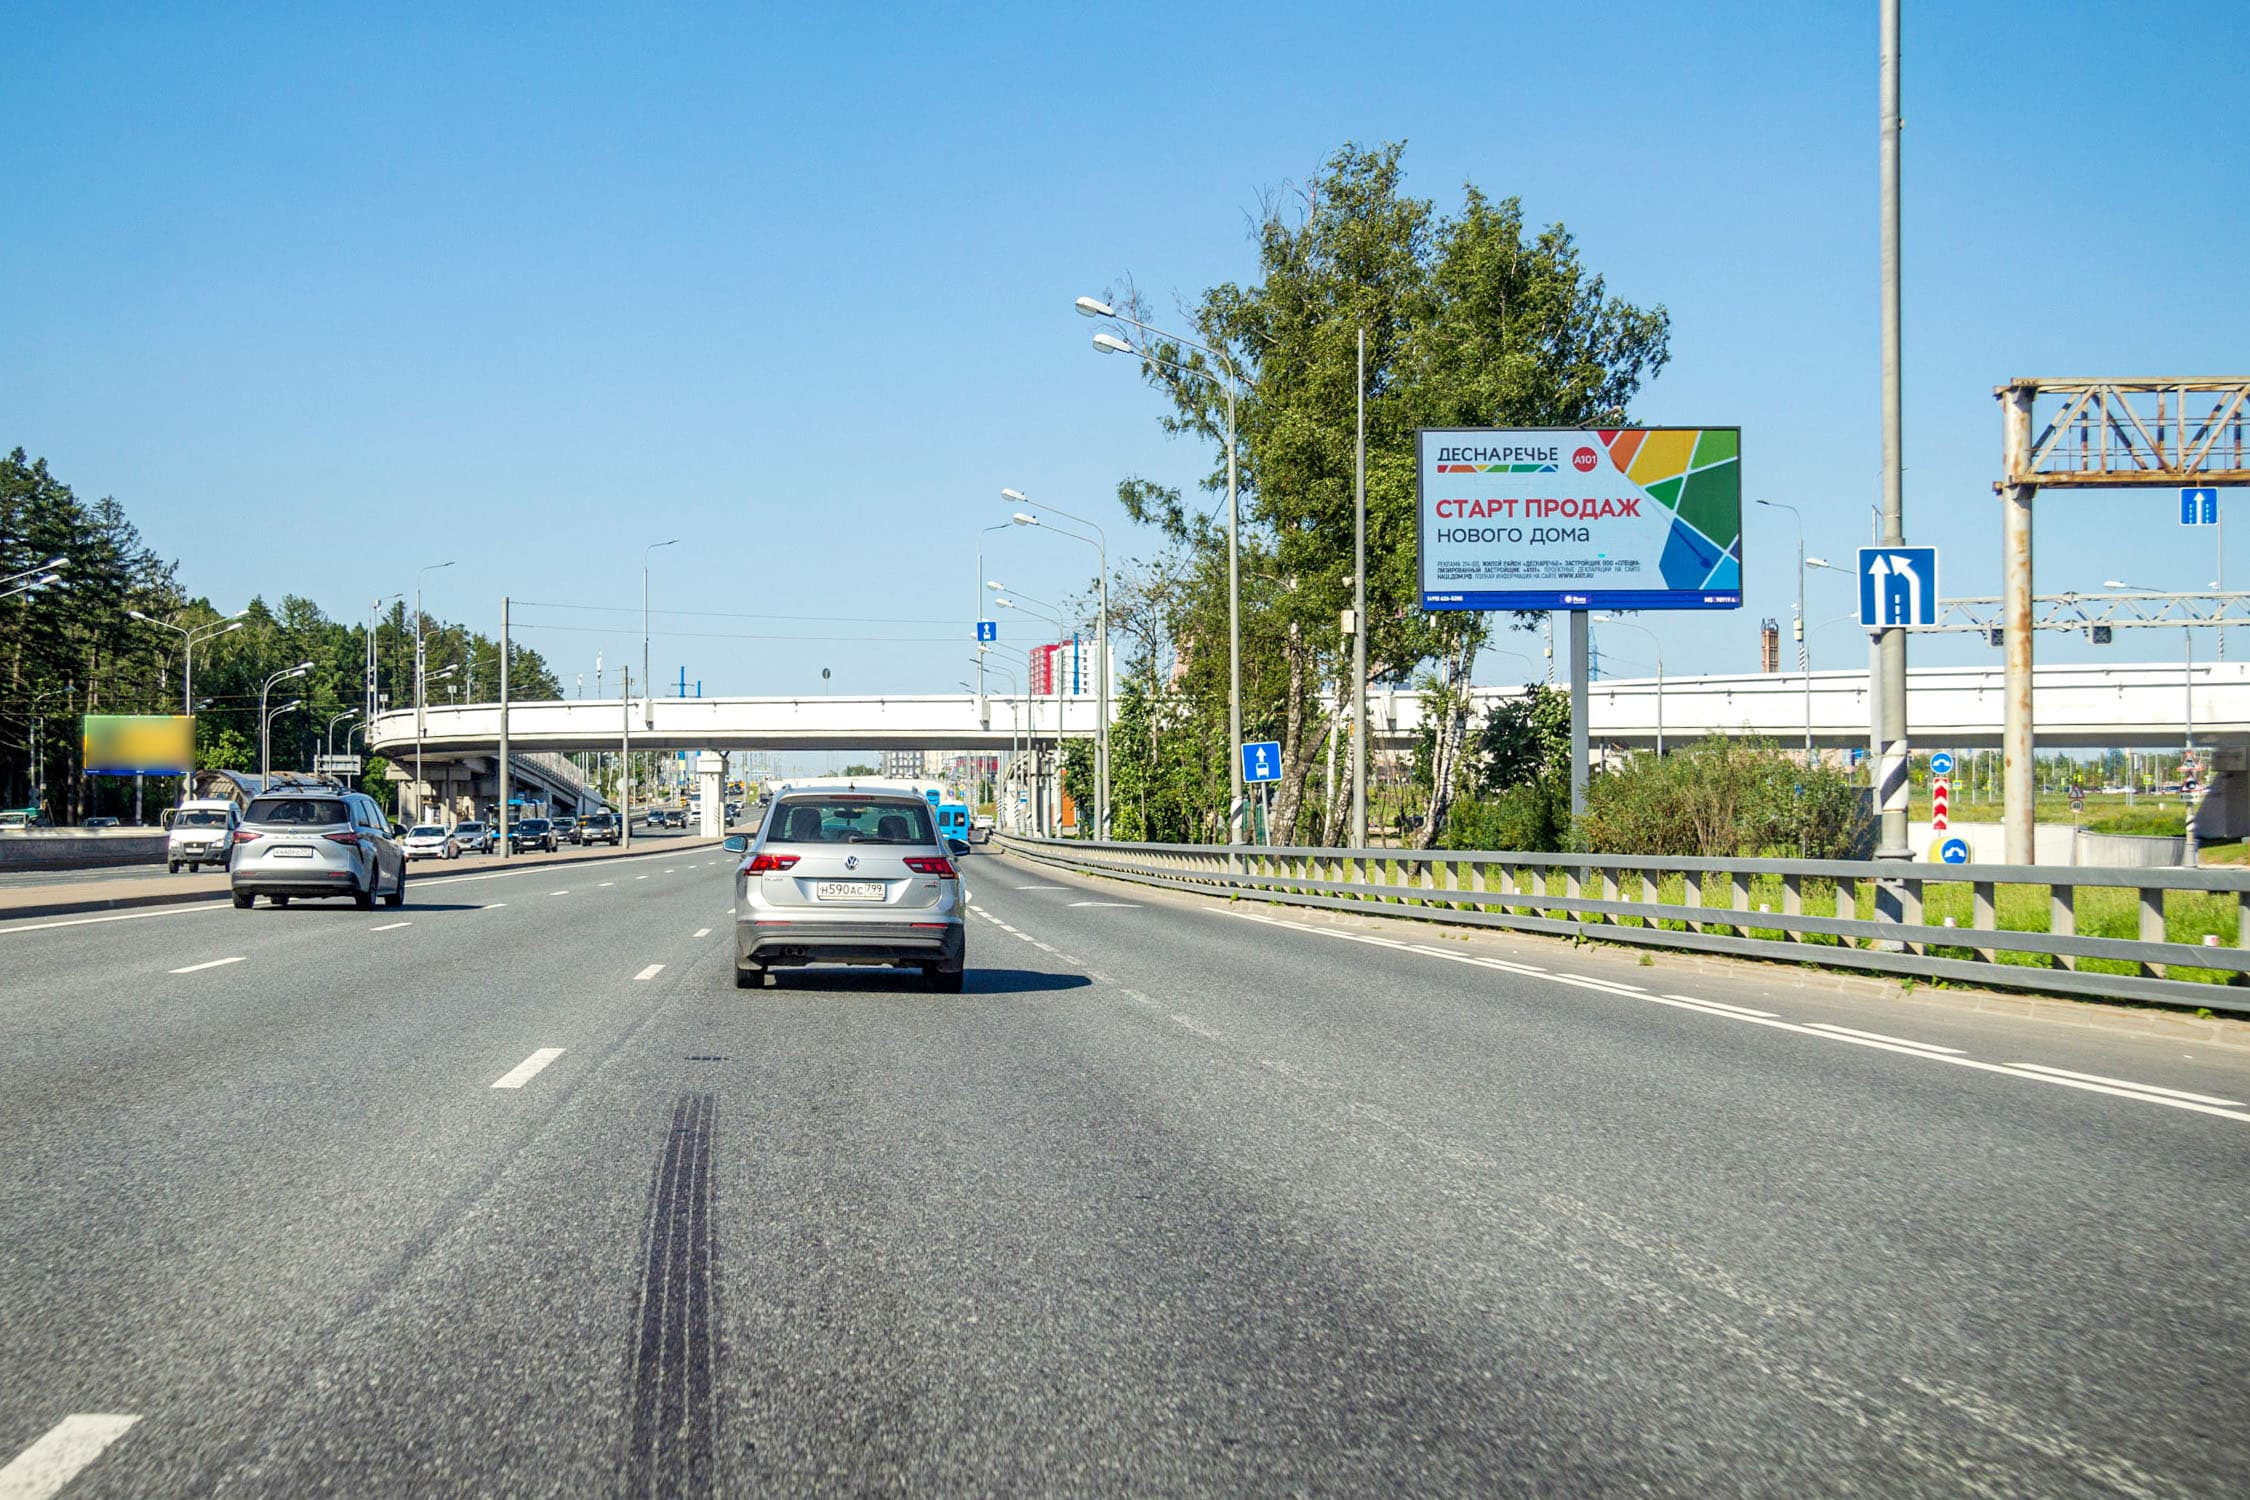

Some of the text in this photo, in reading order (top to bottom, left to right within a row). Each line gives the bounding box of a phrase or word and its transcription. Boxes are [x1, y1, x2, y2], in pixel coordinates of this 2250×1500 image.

[1437, 447, 1559, 461] ДЕСНАРЕЧЬЕ
[1436, 498, 1641, 520] СТАРТ ПРОДАЖ
